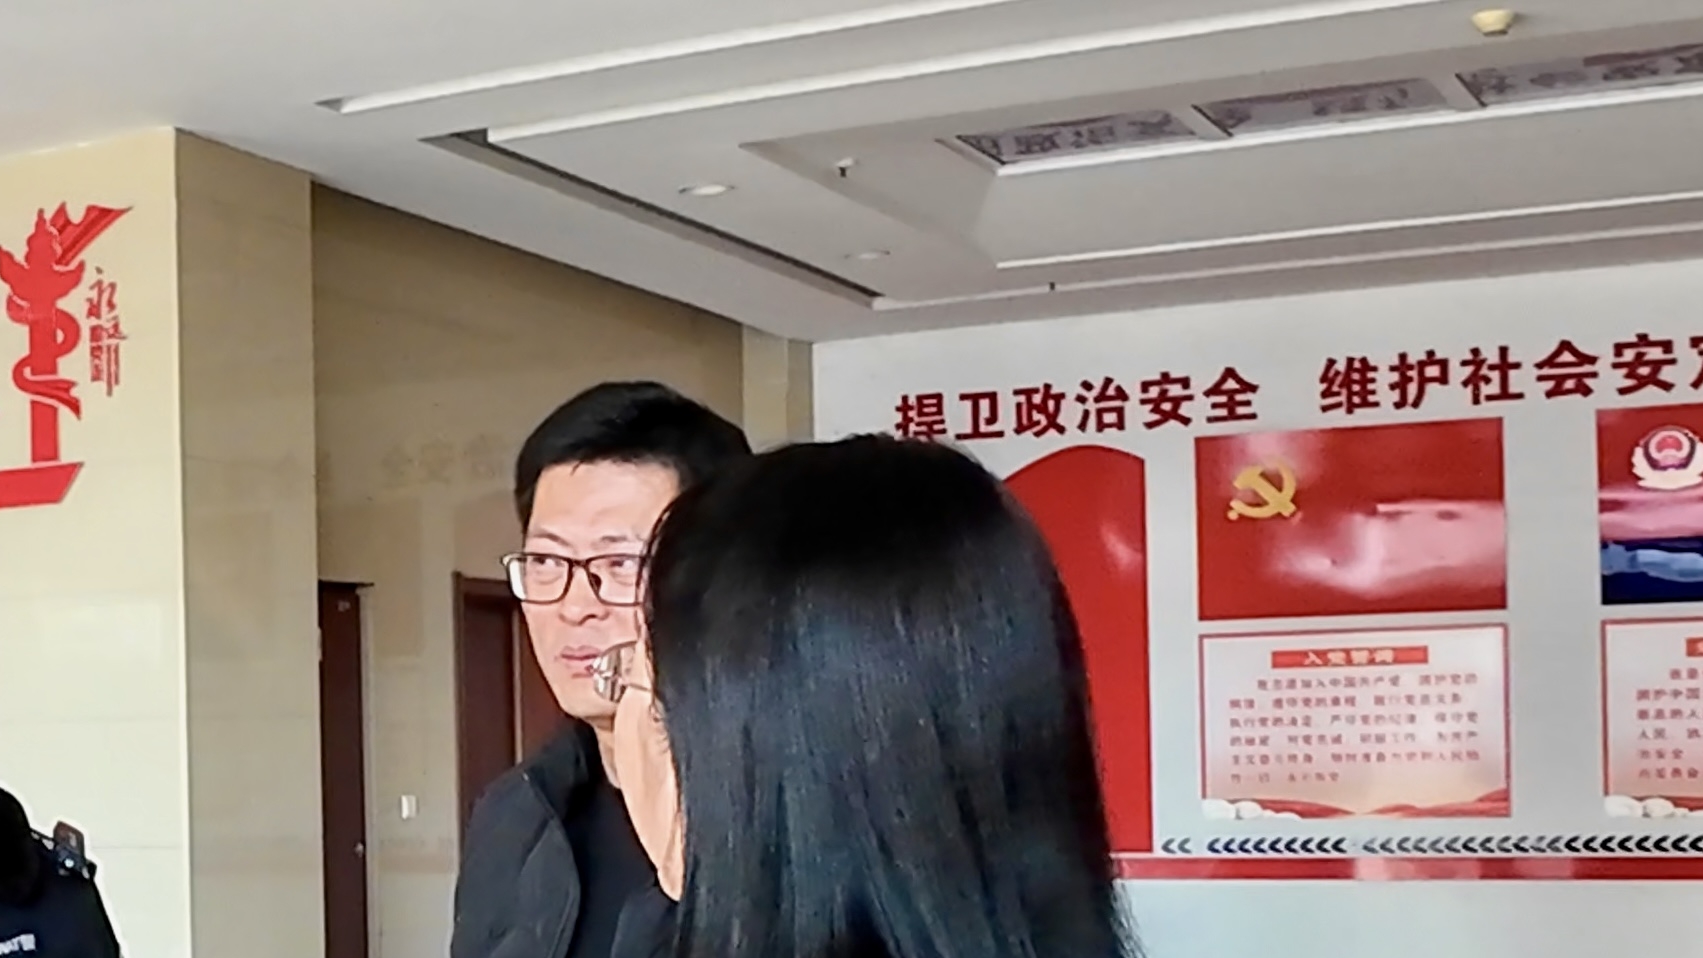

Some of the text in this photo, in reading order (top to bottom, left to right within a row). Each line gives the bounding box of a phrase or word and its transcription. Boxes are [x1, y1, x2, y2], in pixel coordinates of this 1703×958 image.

[894, 333, 1703, 440] 捍卫政治安全 维护社会安
